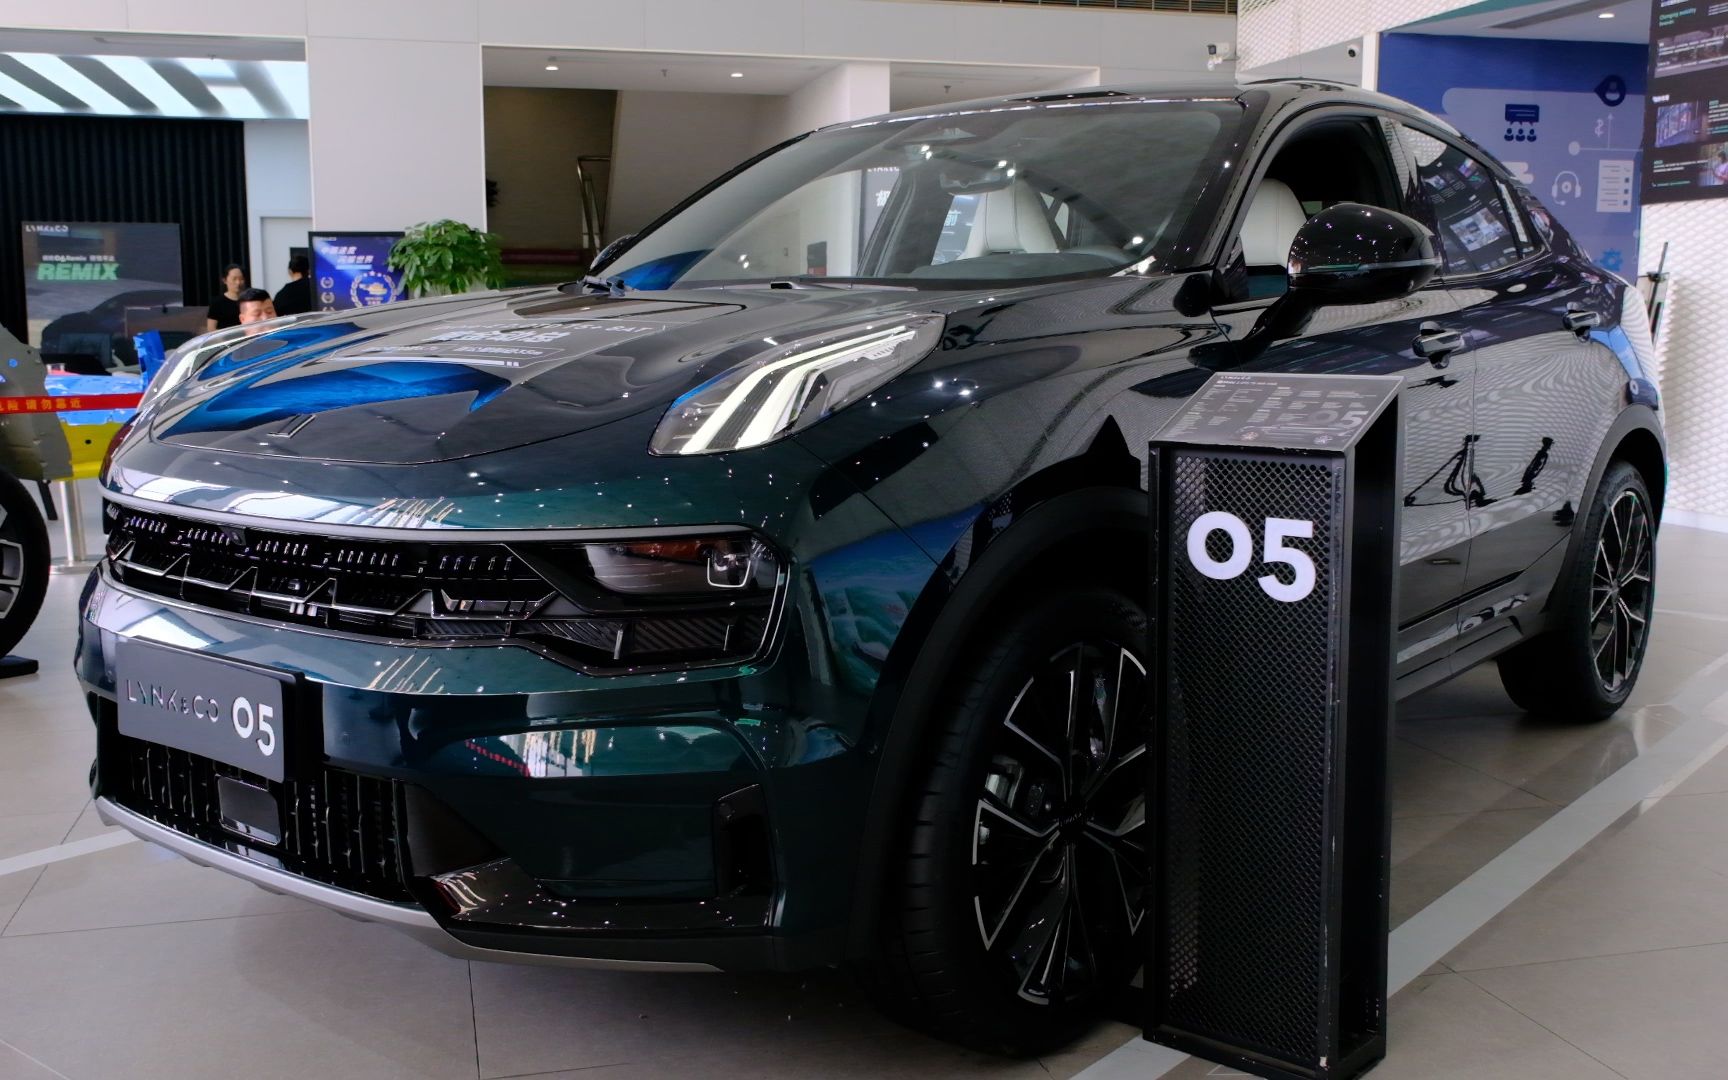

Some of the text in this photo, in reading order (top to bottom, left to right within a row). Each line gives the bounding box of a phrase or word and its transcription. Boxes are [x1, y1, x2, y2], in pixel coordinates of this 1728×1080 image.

[37, 263, 119, 281] REMIX
[1187, 510, 1316, 603] 05
[126, 679, 276, 757] LYNK&CO 05
